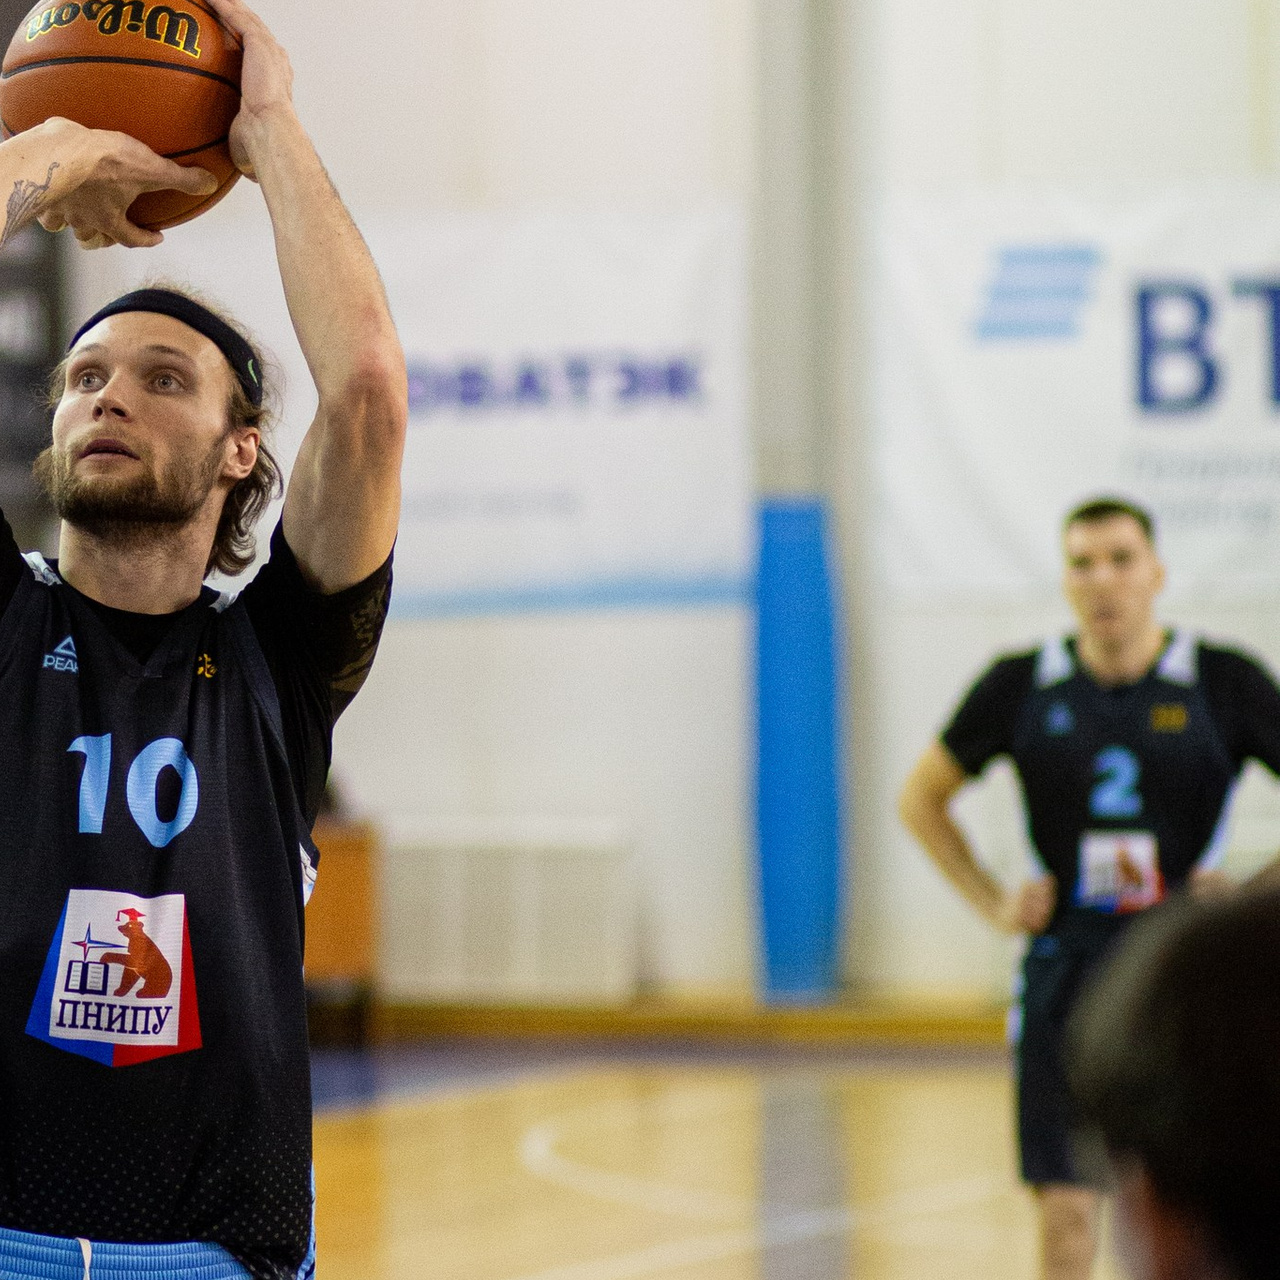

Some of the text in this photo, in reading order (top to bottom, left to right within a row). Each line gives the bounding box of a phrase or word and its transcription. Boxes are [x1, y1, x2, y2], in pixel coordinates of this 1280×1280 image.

[67, 733, 199, 848] 10
[1089, 745, 1143, 819] 2
[56, 999, 173, 1035] ПНИПУ
